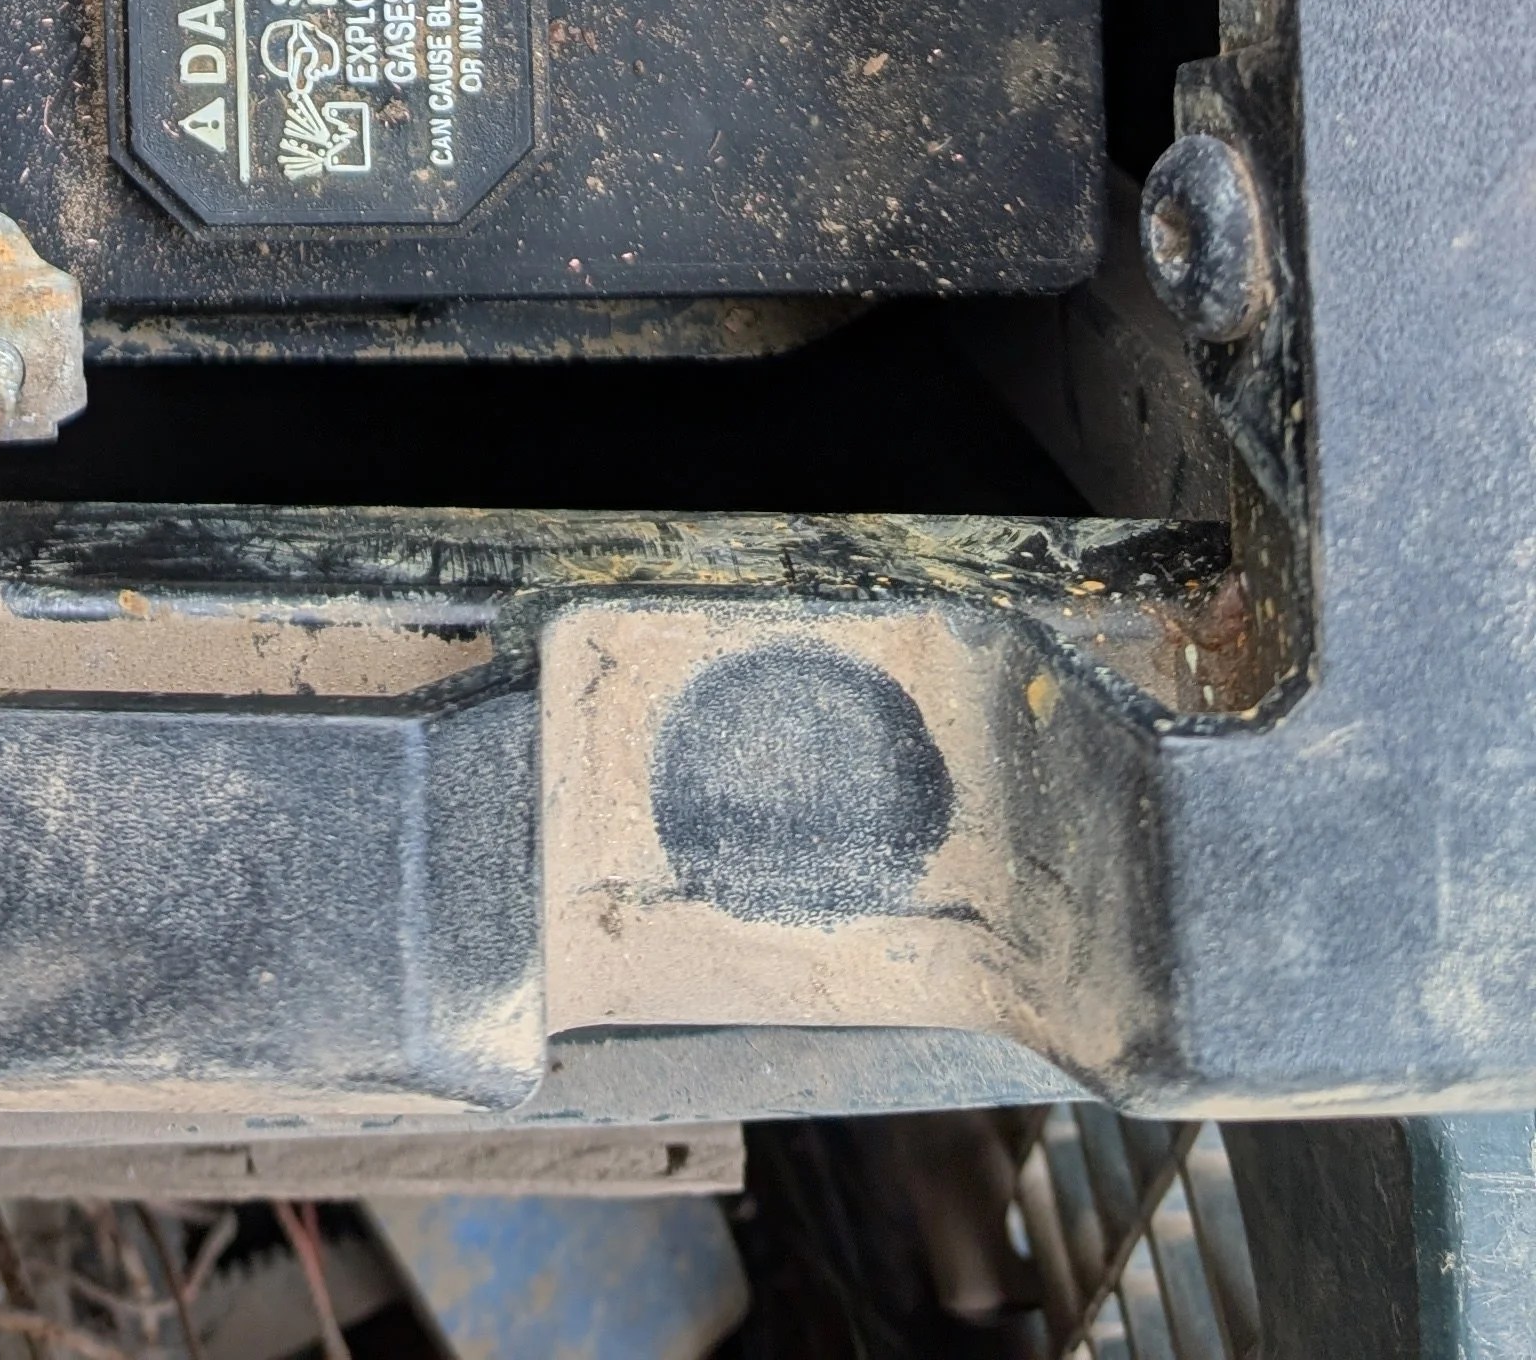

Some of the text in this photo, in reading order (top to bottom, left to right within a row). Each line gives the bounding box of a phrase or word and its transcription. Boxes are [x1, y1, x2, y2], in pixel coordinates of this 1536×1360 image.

[427, 35, 454, 110] CAUSE
[460, 58, 484, 92] OR
[429, 119, 453, 166] CAN
